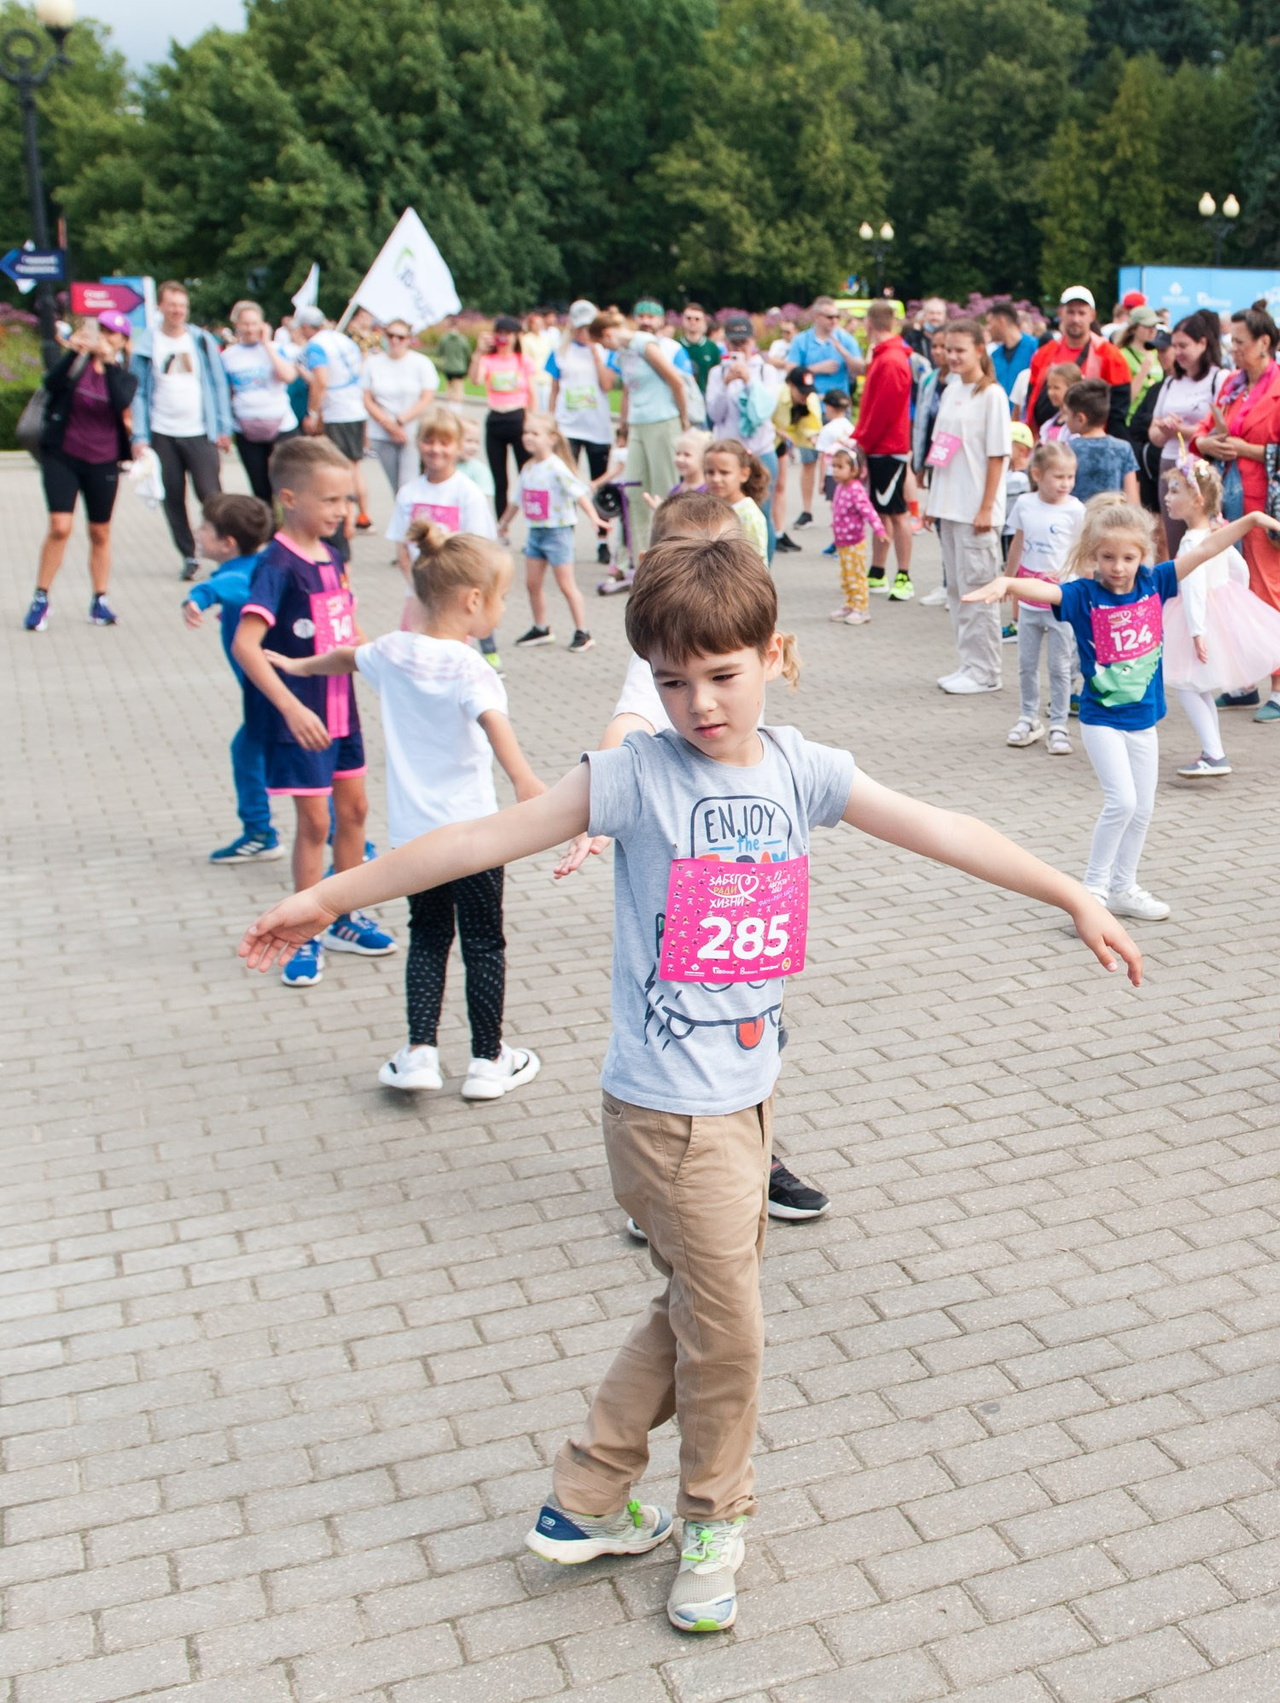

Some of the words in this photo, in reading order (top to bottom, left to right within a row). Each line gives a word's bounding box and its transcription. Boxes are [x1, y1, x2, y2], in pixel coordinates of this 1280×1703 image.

[1110, 624, 1153, 652] 124
[704, 803, 775, 843] ENJOY
[736, 834, 760, 853] the
[709, 873, 740, 886] ЗАБЕГ
[713, 886, 738, 896] РАДИ
[709, 896, 745, 909] ЖИЗНИ
[697, 913, 790, 960] 285
